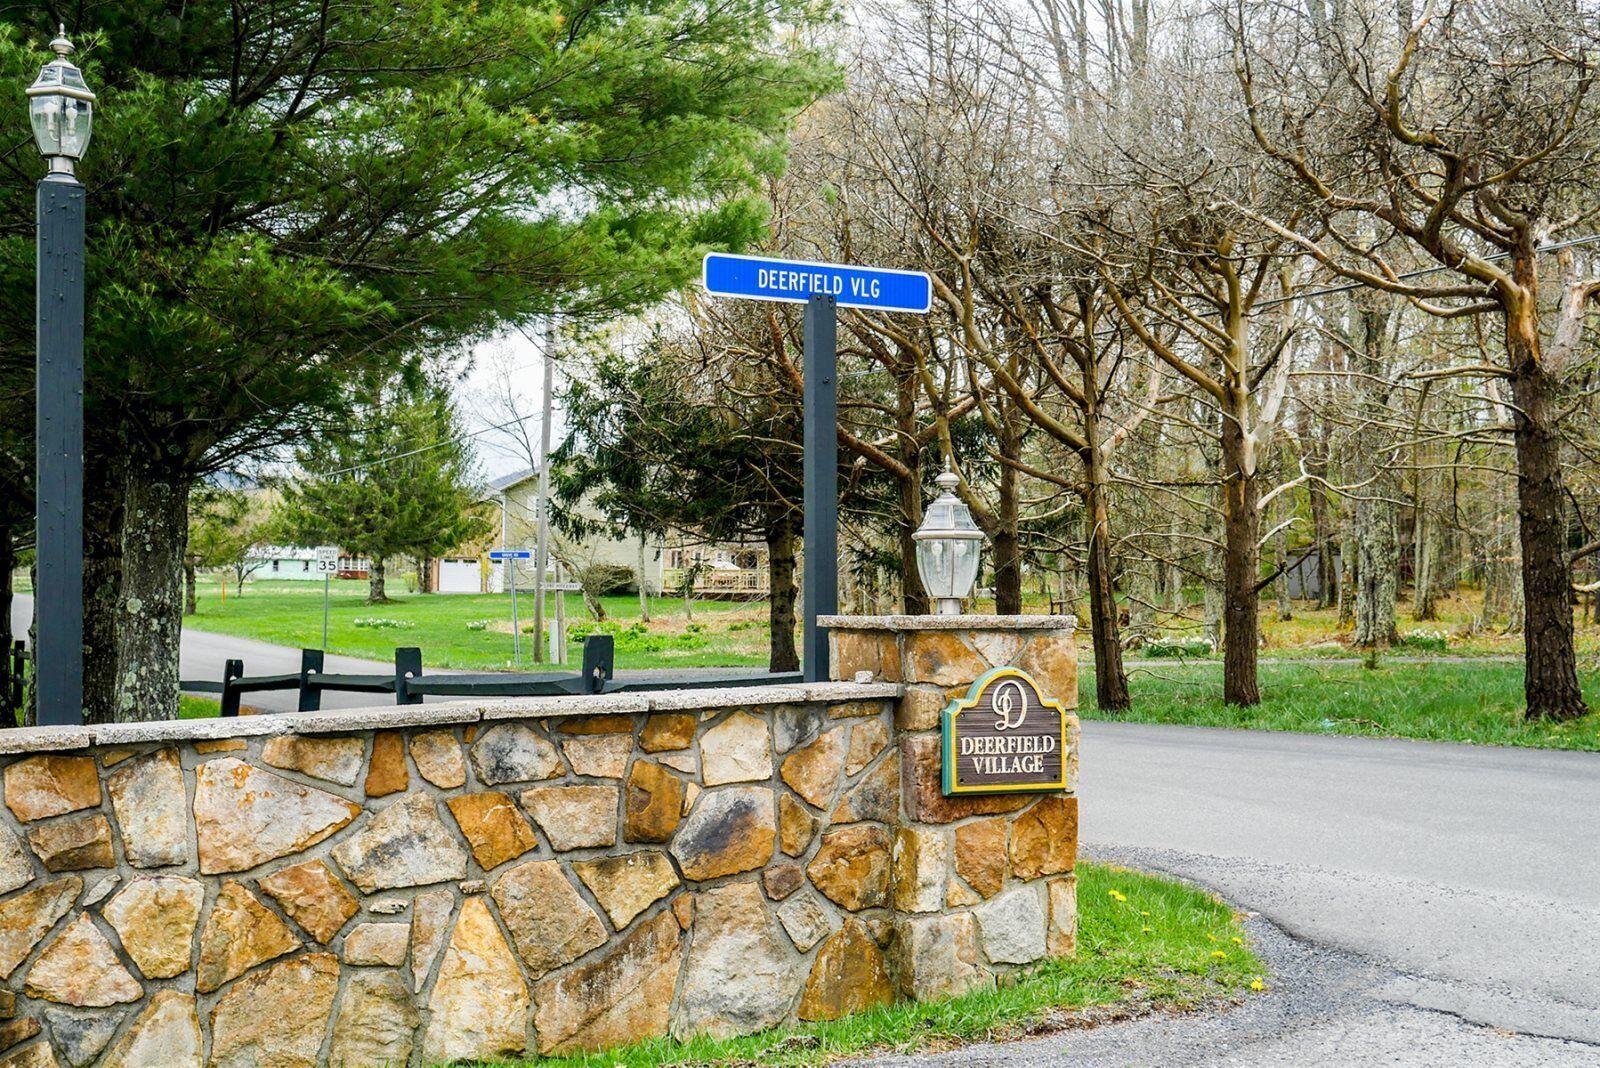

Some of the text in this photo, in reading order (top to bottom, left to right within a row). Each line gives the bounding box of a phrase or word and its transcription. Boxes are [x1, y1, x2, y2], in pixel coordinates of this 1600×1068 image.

[758, 268, 880, 298] DEERFIELD VLG
[319, 560, 336, 571] 35
[960, 735, 1056, 755] DEERFIELD
[972, 755, 1045, 774] VILLAGE
